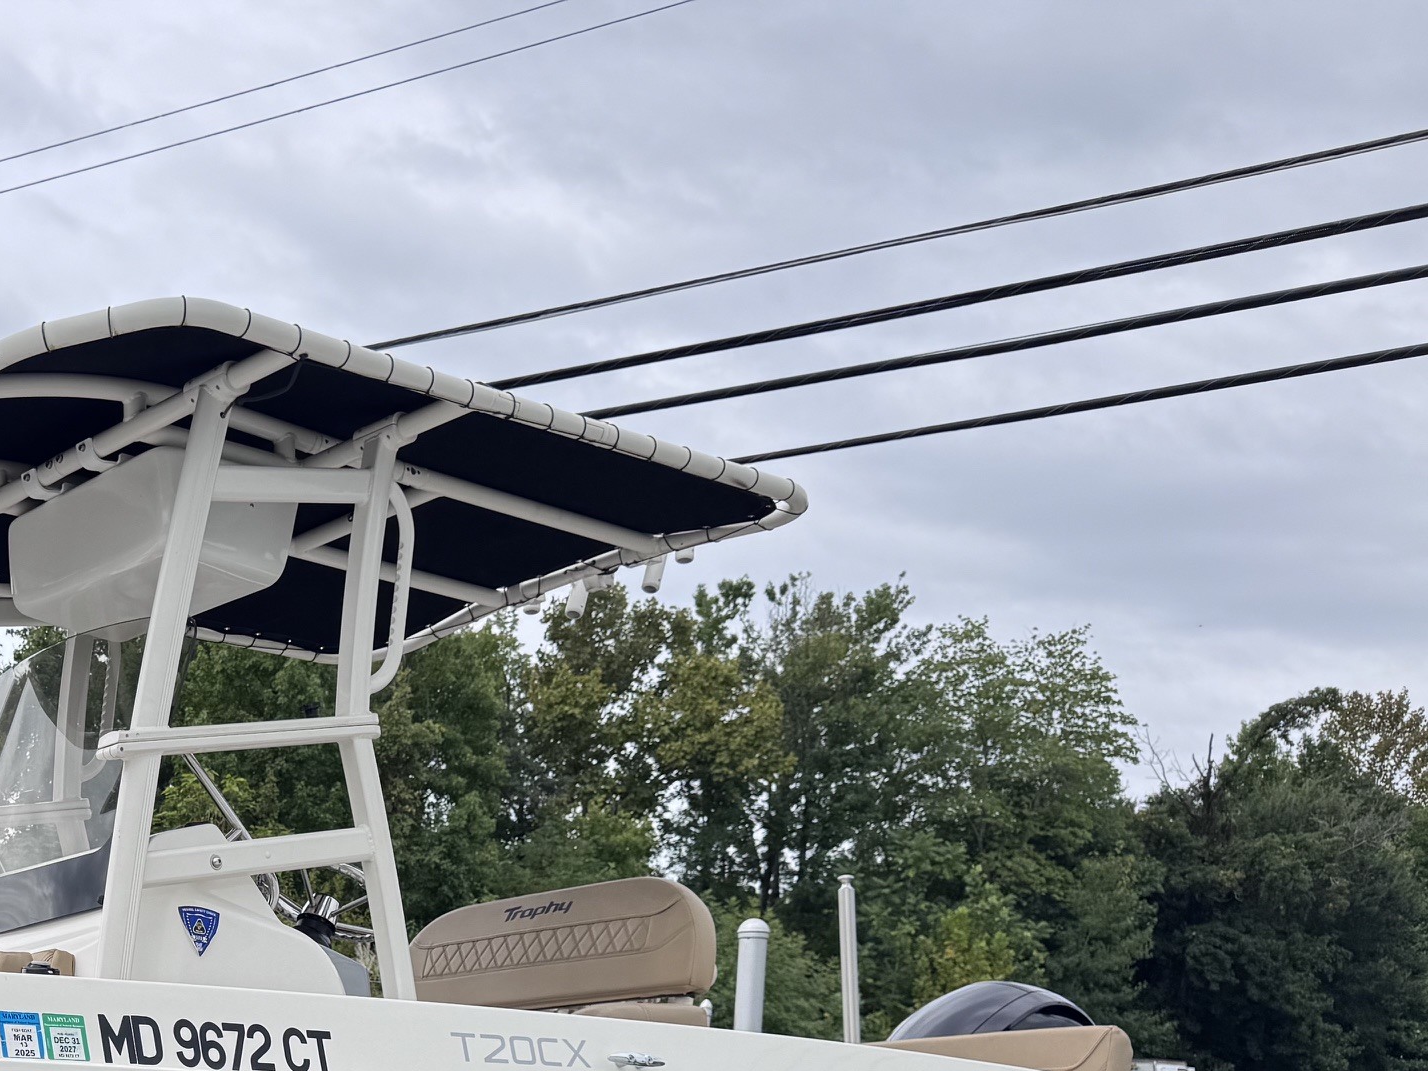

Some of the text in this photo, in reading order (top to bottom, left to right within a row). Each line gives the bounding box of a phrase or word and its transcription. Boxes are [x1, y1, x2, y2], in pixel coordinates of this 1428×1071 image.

[503, 901, 573, 923] Trophy
[2, 1012, 36, 1020] MARYLAND
[13, 1034, 33, 1042] MAR
[53, 1036, 81, 1045] DEC 31
[97, 1014, 163, 1065] MD
[173, 1018, 276, 1071] 9672
[14, 1048, 36, 1057] 2025
[59, 1045, 77, 1053] 2027
[450, 1032, 591, 1069] T20CX
